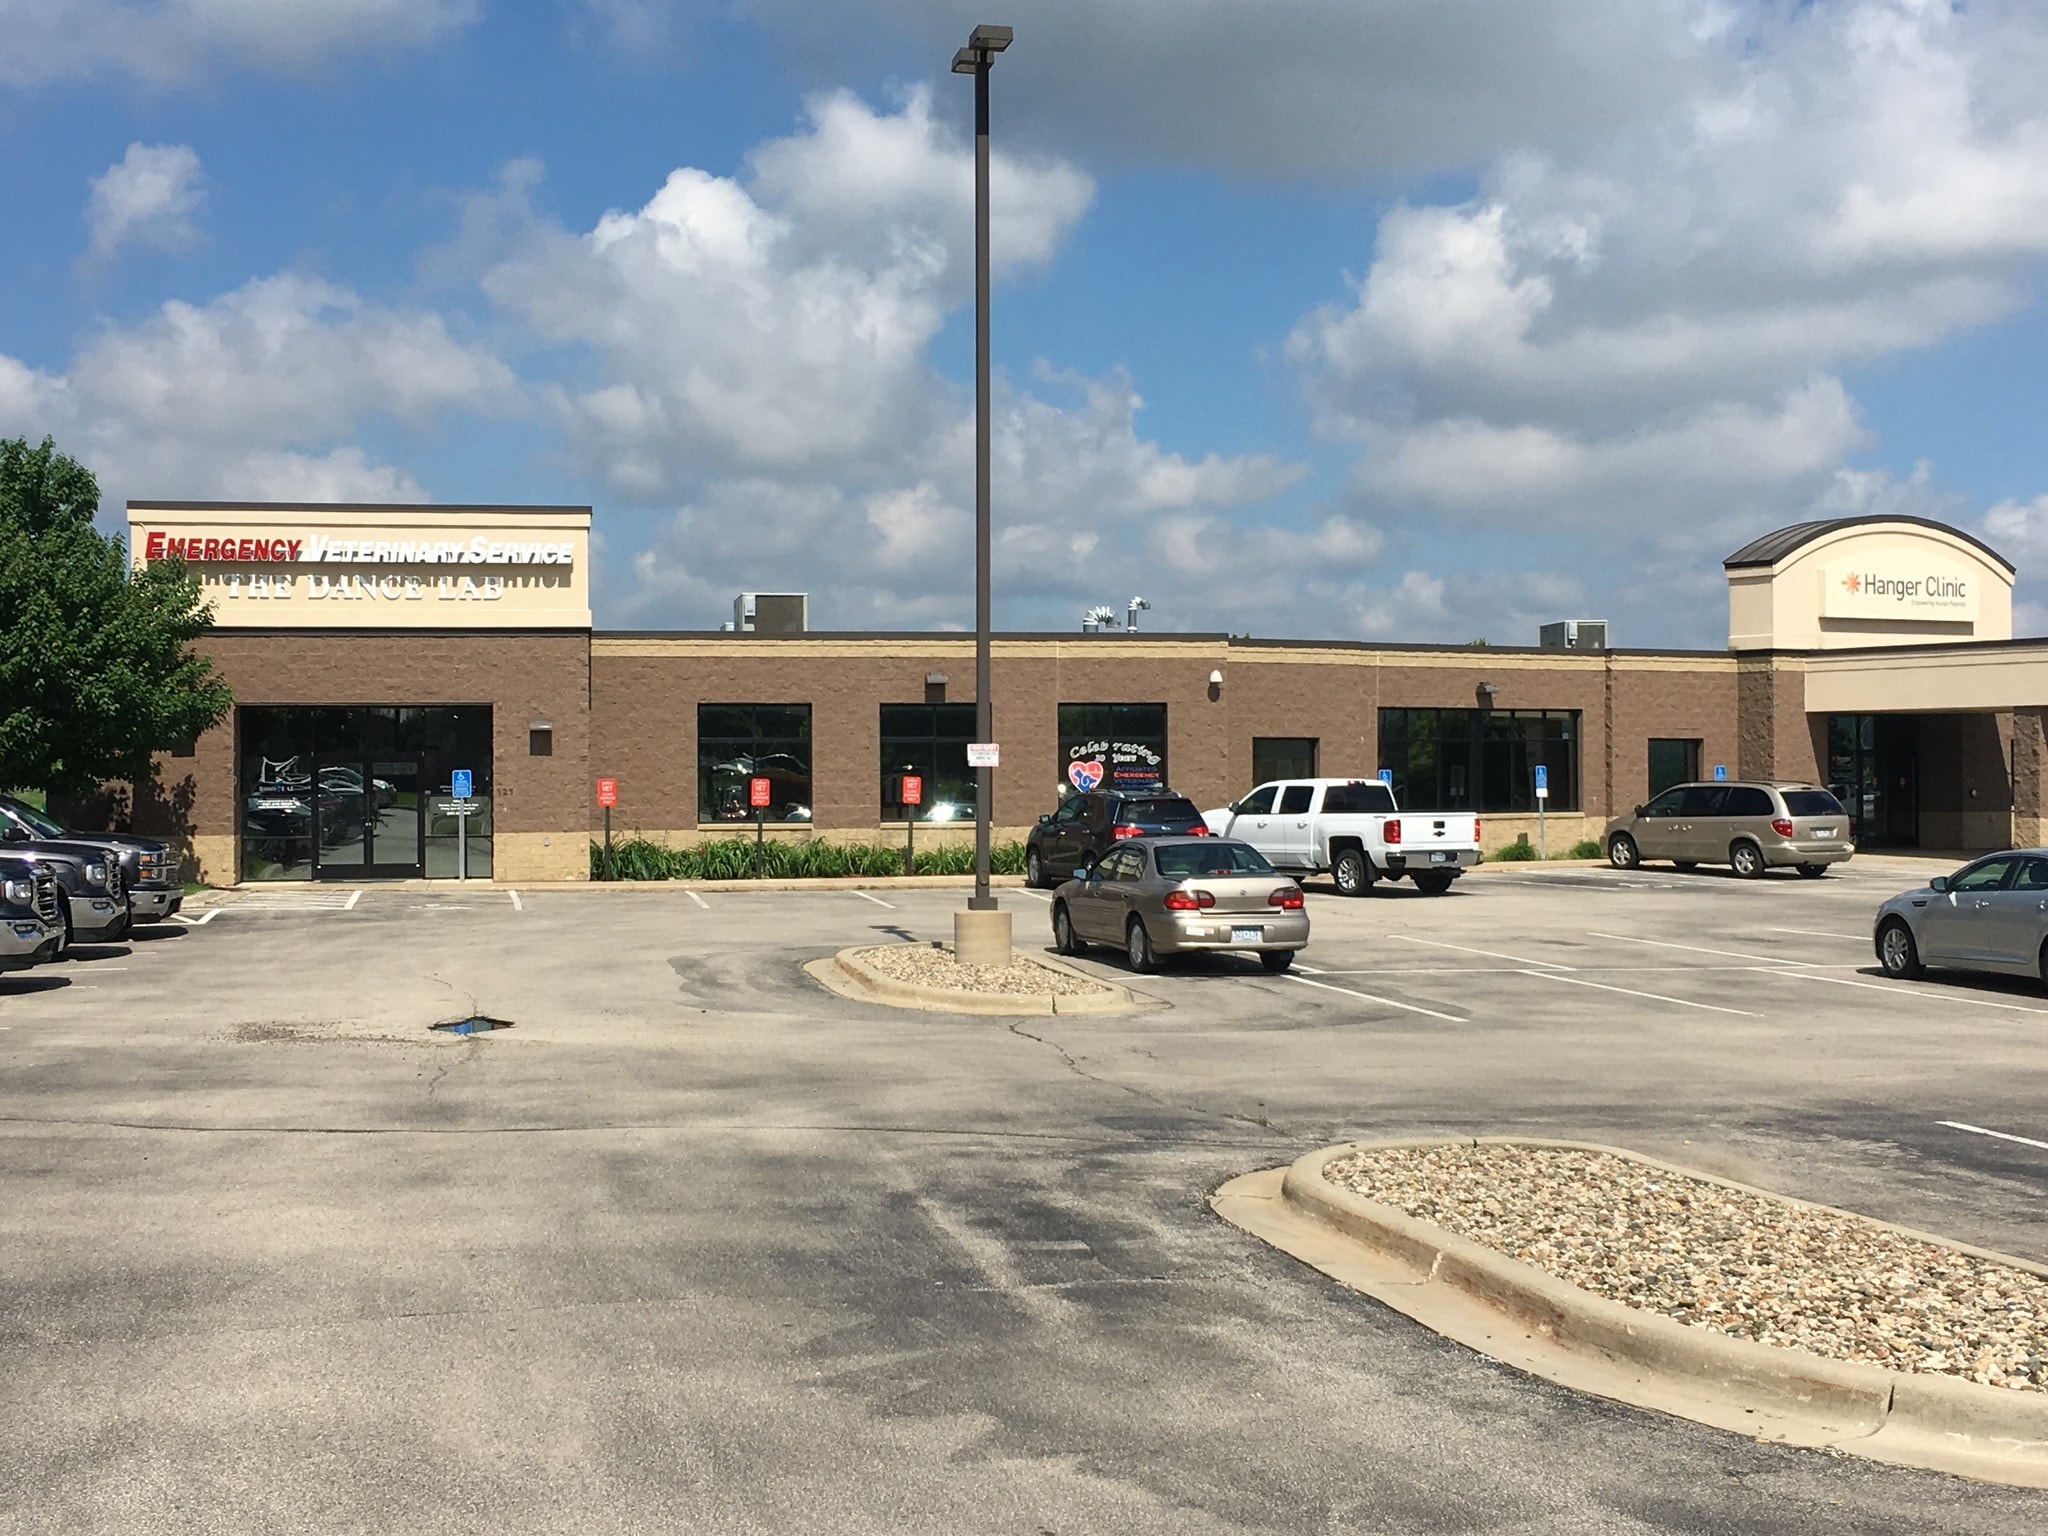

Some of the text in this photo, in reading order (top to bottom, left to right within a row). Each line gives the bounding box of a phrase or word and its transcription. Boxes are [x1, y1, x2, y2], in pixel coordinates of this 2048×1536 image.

[145, 531, 575, 565] EMERGENCY VETERINARY SERVICE
[224, 573, 503, 601] THE DANCE LAB
[1865, 573, 1966, 601] Hanger Clinic
